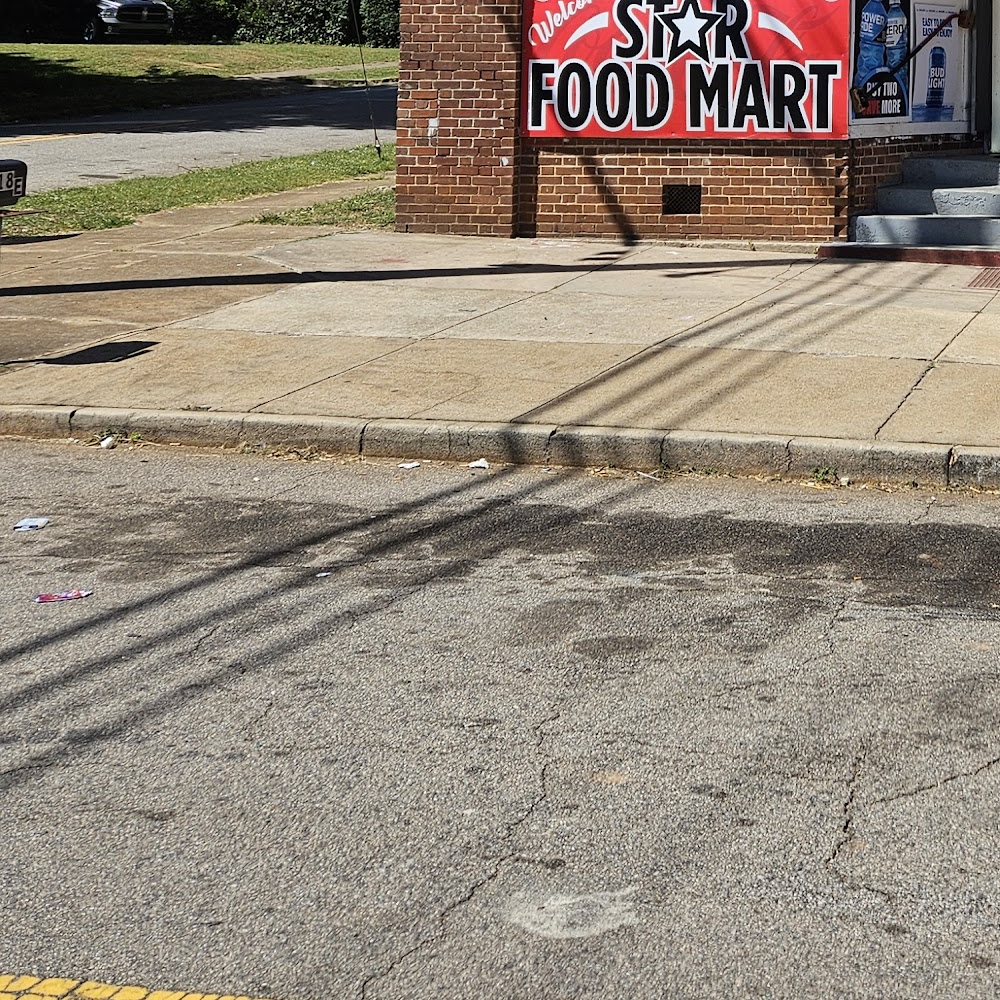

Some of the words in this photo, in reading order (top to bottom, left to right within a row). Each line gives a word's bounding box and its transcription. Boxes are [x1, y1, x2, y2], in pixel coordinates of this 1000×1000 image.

[930, 67, 945, 78] BUD
[528, 59, 674, 131] FOOD
[686, 59, 842, 132] MART
[883, 81, 898, 97] TWO
[881, 99, 901, 114] MORE
